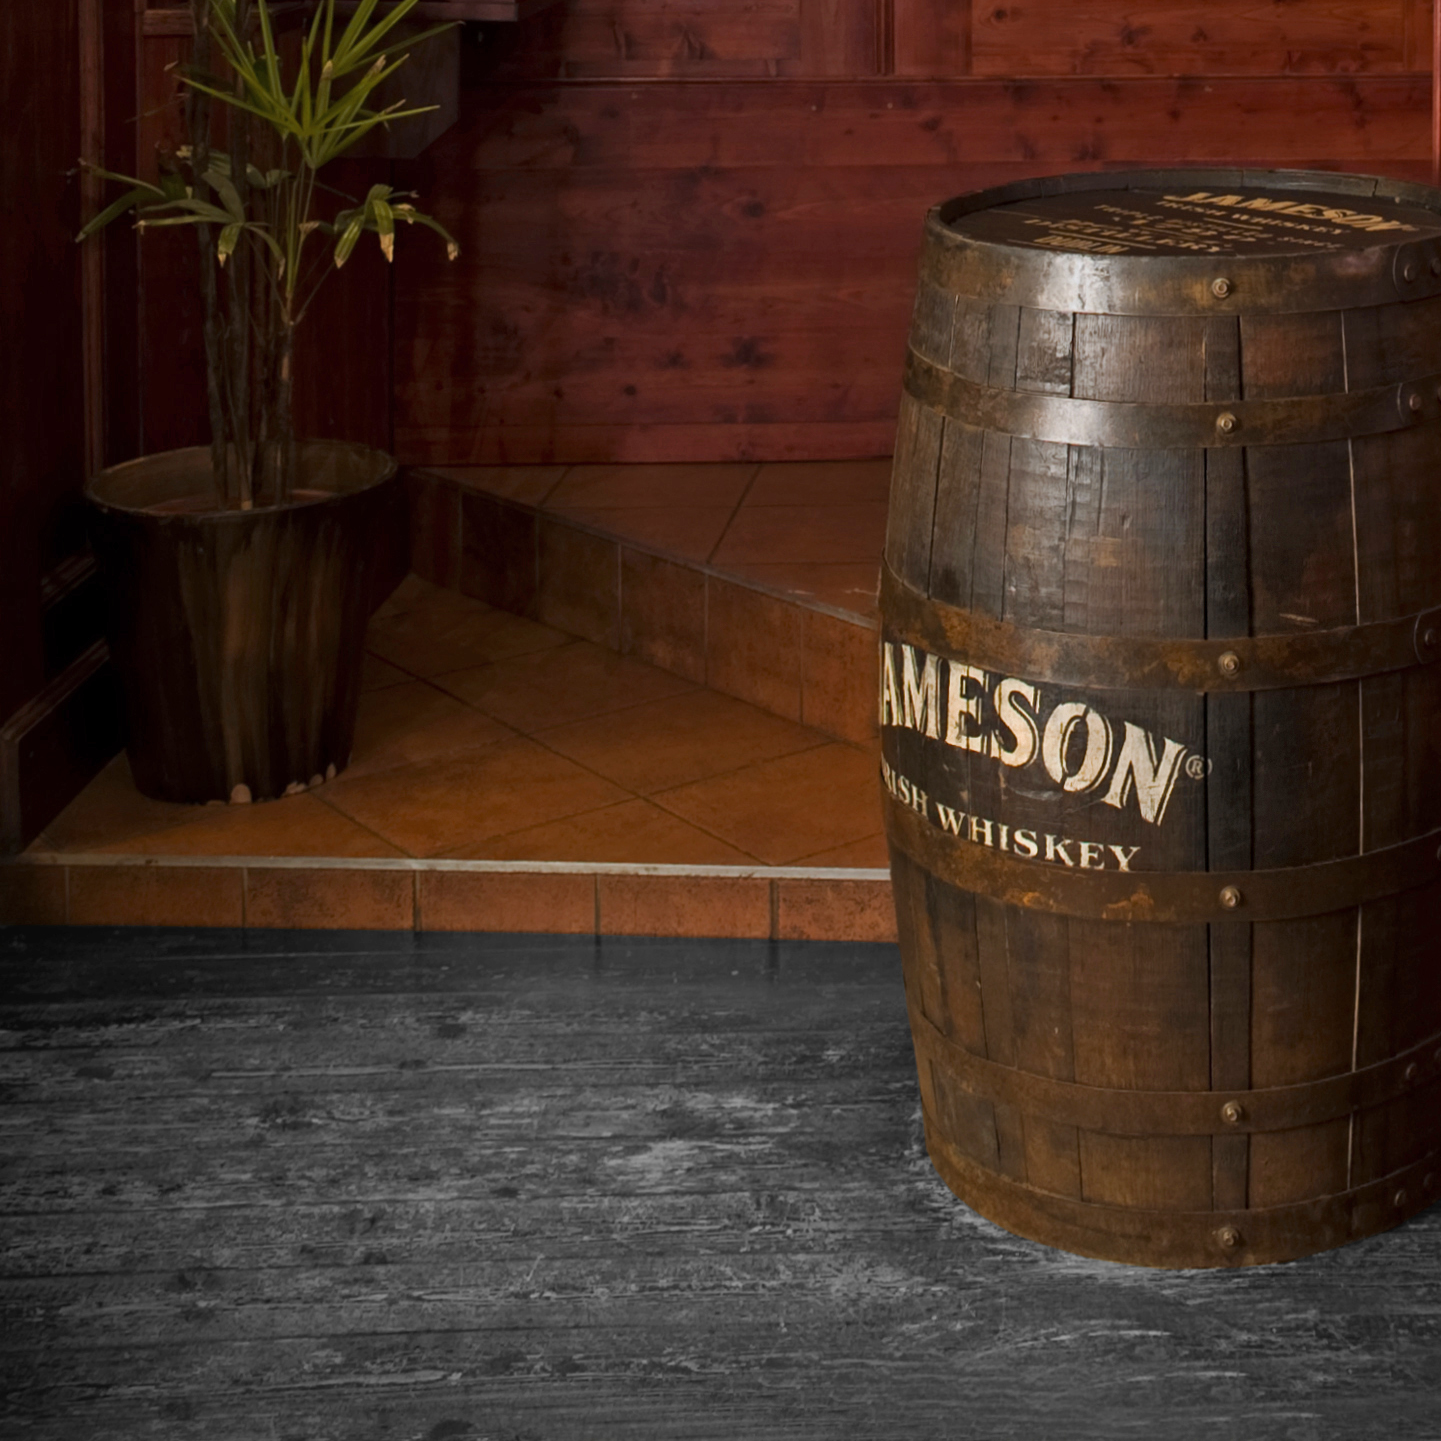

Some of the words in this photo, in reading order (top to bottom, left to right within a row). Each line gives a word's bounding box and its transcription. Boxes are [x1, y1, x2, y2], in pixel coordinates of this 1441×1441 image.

[1163, 192, 1401, 232] JAMESON
[882, 641, 1187, 826] AMESON
[881, 751, 929, 819] RISH
[936, 801, 1141, 872] WHISKEY
